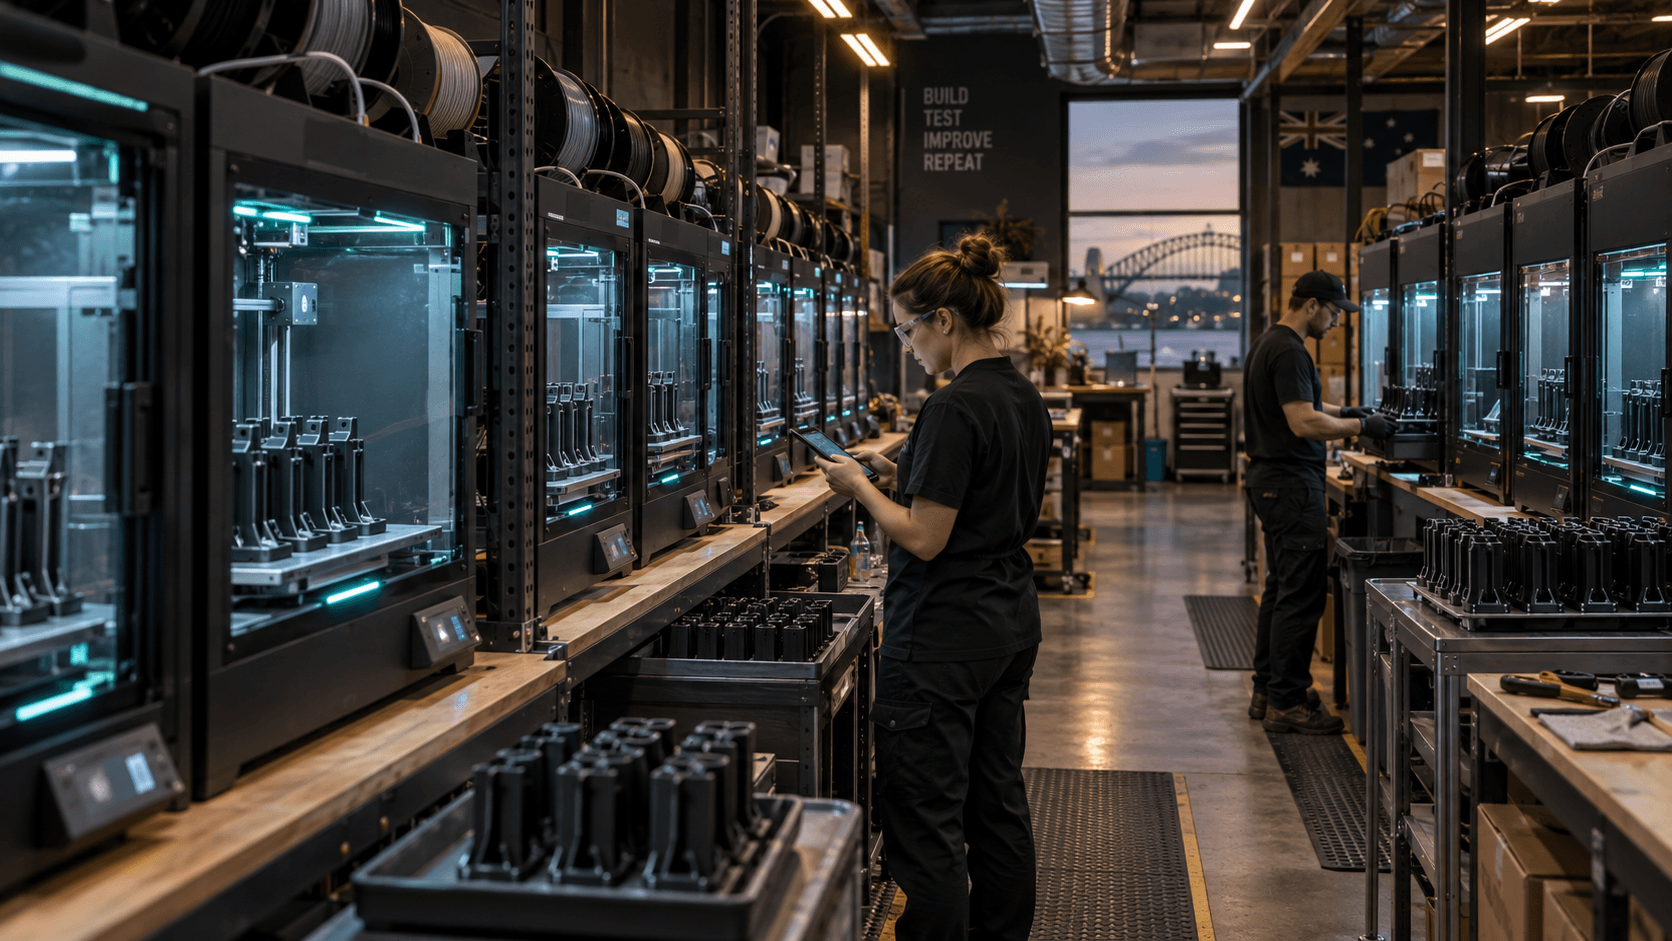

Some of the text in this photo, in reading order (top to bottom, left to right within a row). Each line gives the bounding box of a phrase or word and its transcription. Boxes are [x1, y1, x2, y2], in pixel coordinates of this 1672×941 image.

[923, 86, 969, 105] BUILD
[923, 109, 963, 127] TEST
[923, 131, 993, 149] IMPROVE
[923, 153, 984, 171] REPEAT
